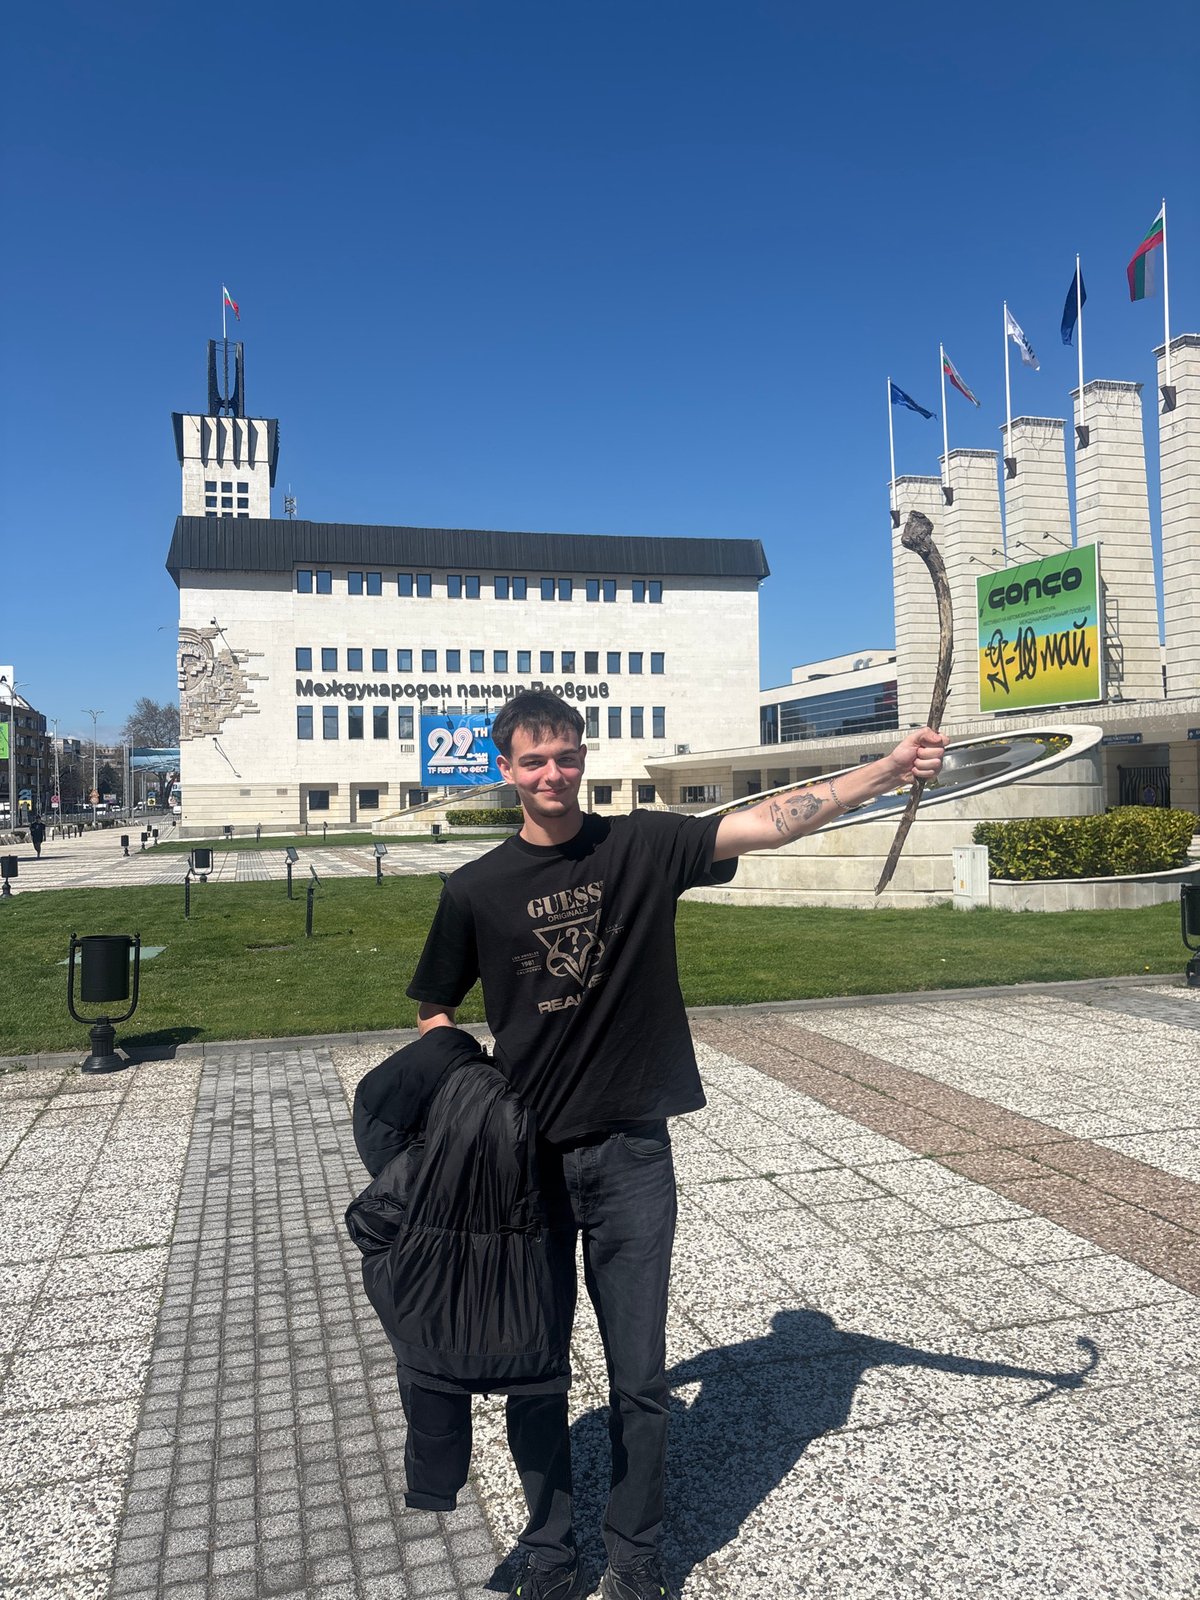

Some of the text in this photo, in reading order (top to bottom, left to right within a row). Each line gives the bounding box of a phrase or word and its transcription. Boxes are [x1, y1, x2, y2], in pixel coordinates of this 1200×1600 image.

[1040, 617, 1090, 672] май
[295, 678, 453, 701] Международен
[437, 766, 455, 774] FEST
[527, 881, 602, 919] GUESS
[547, 906, 589, 922] ORIGINALS
